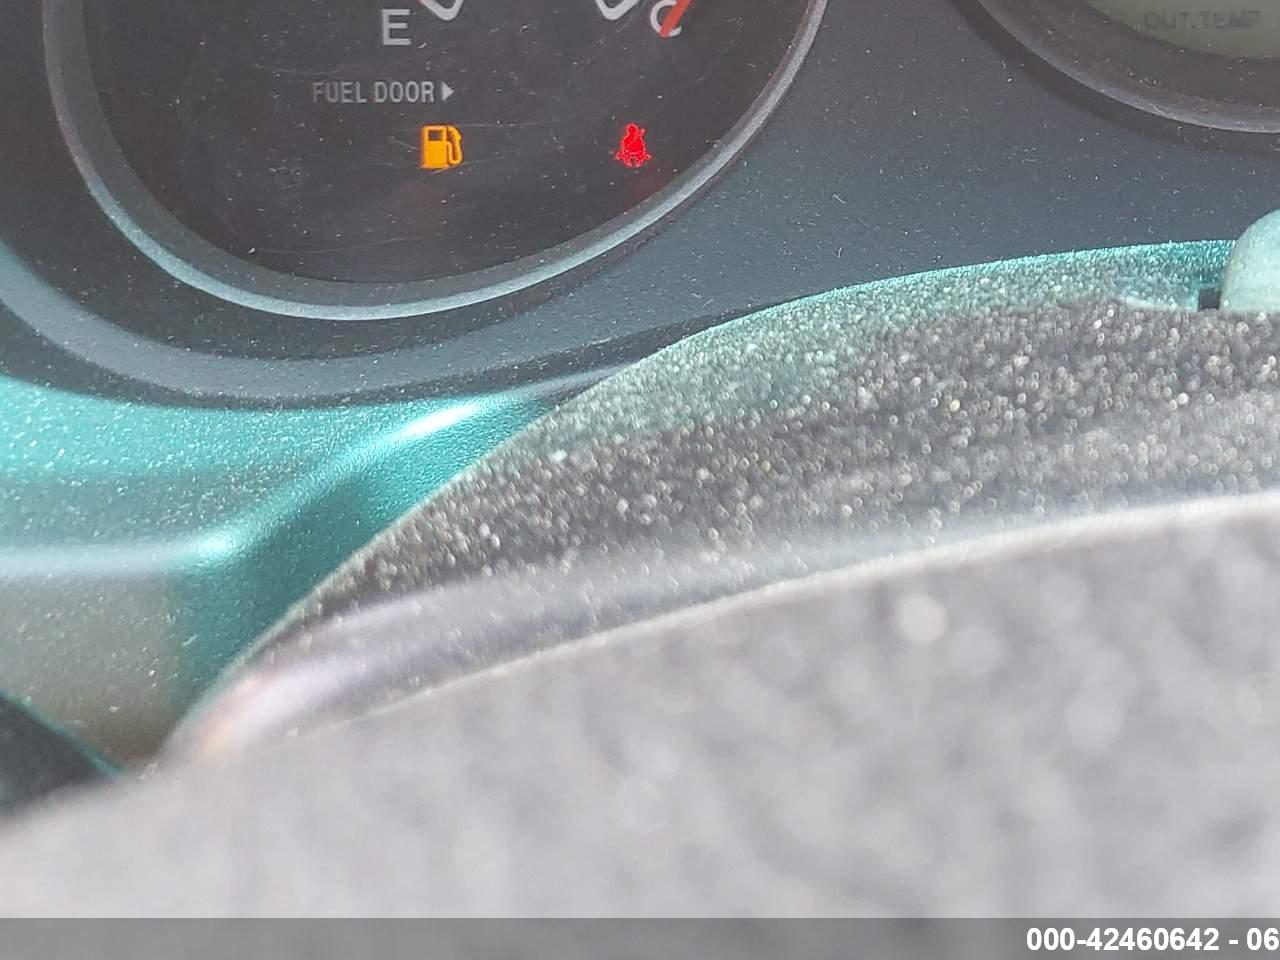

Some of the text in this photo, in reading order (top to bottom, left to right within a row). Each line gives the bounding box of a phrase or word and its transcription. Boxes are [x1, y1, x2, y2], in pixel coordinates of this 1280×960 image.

[382, 8, 411, 46] E
[312, 81, 435, 104] FUEL DOOR
